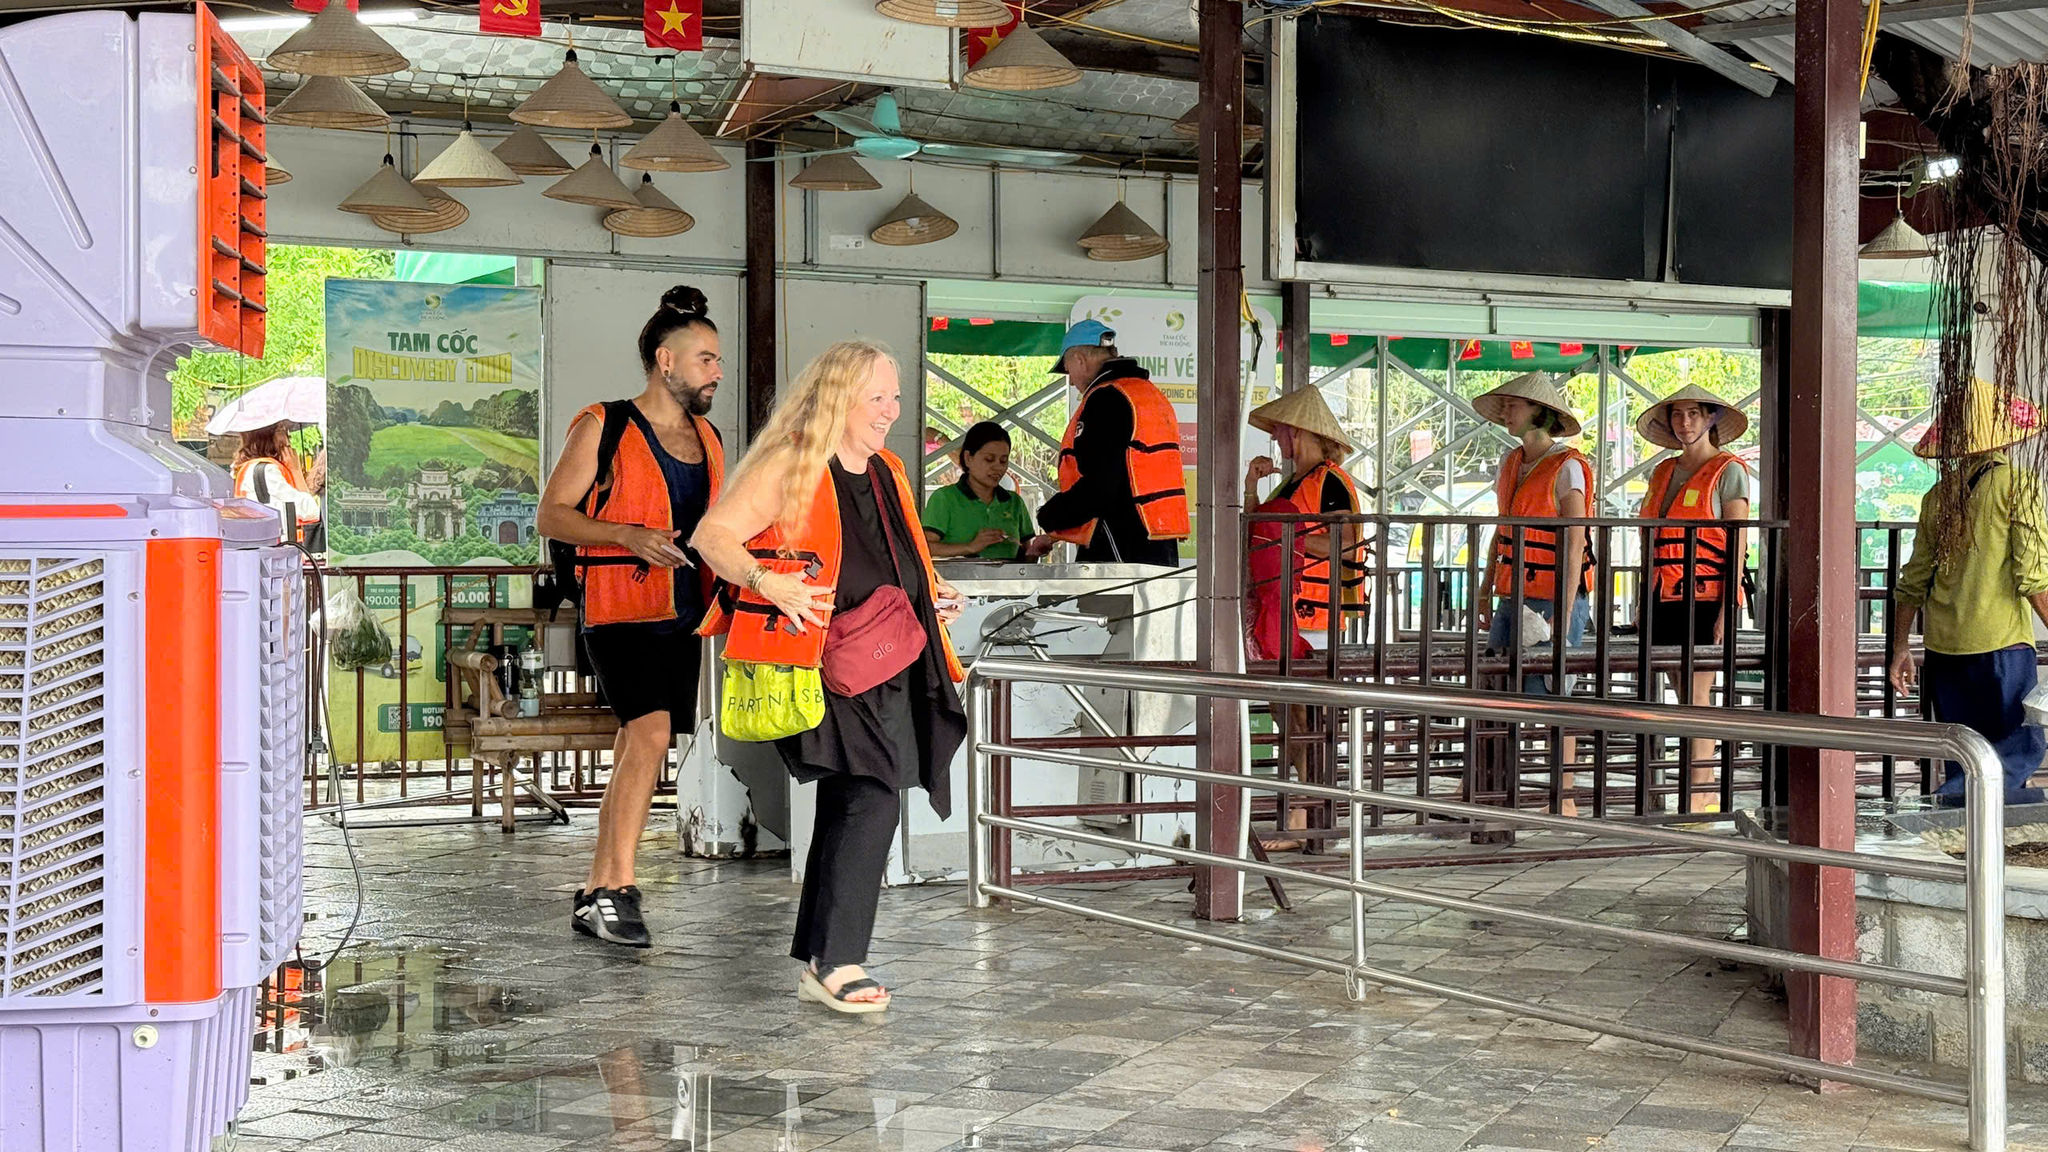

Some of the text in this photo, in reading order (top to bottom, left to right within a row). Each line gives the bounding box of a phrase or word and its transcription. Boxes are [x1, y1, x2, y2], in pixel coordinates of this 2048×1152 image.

[388, 328, 478, 354] TAM CỐC
[352, 346, 513, 384] DISCOVERY TOUR
[443, 591, 491, 604] 50.000
[872, 640, 894, 660] alo
